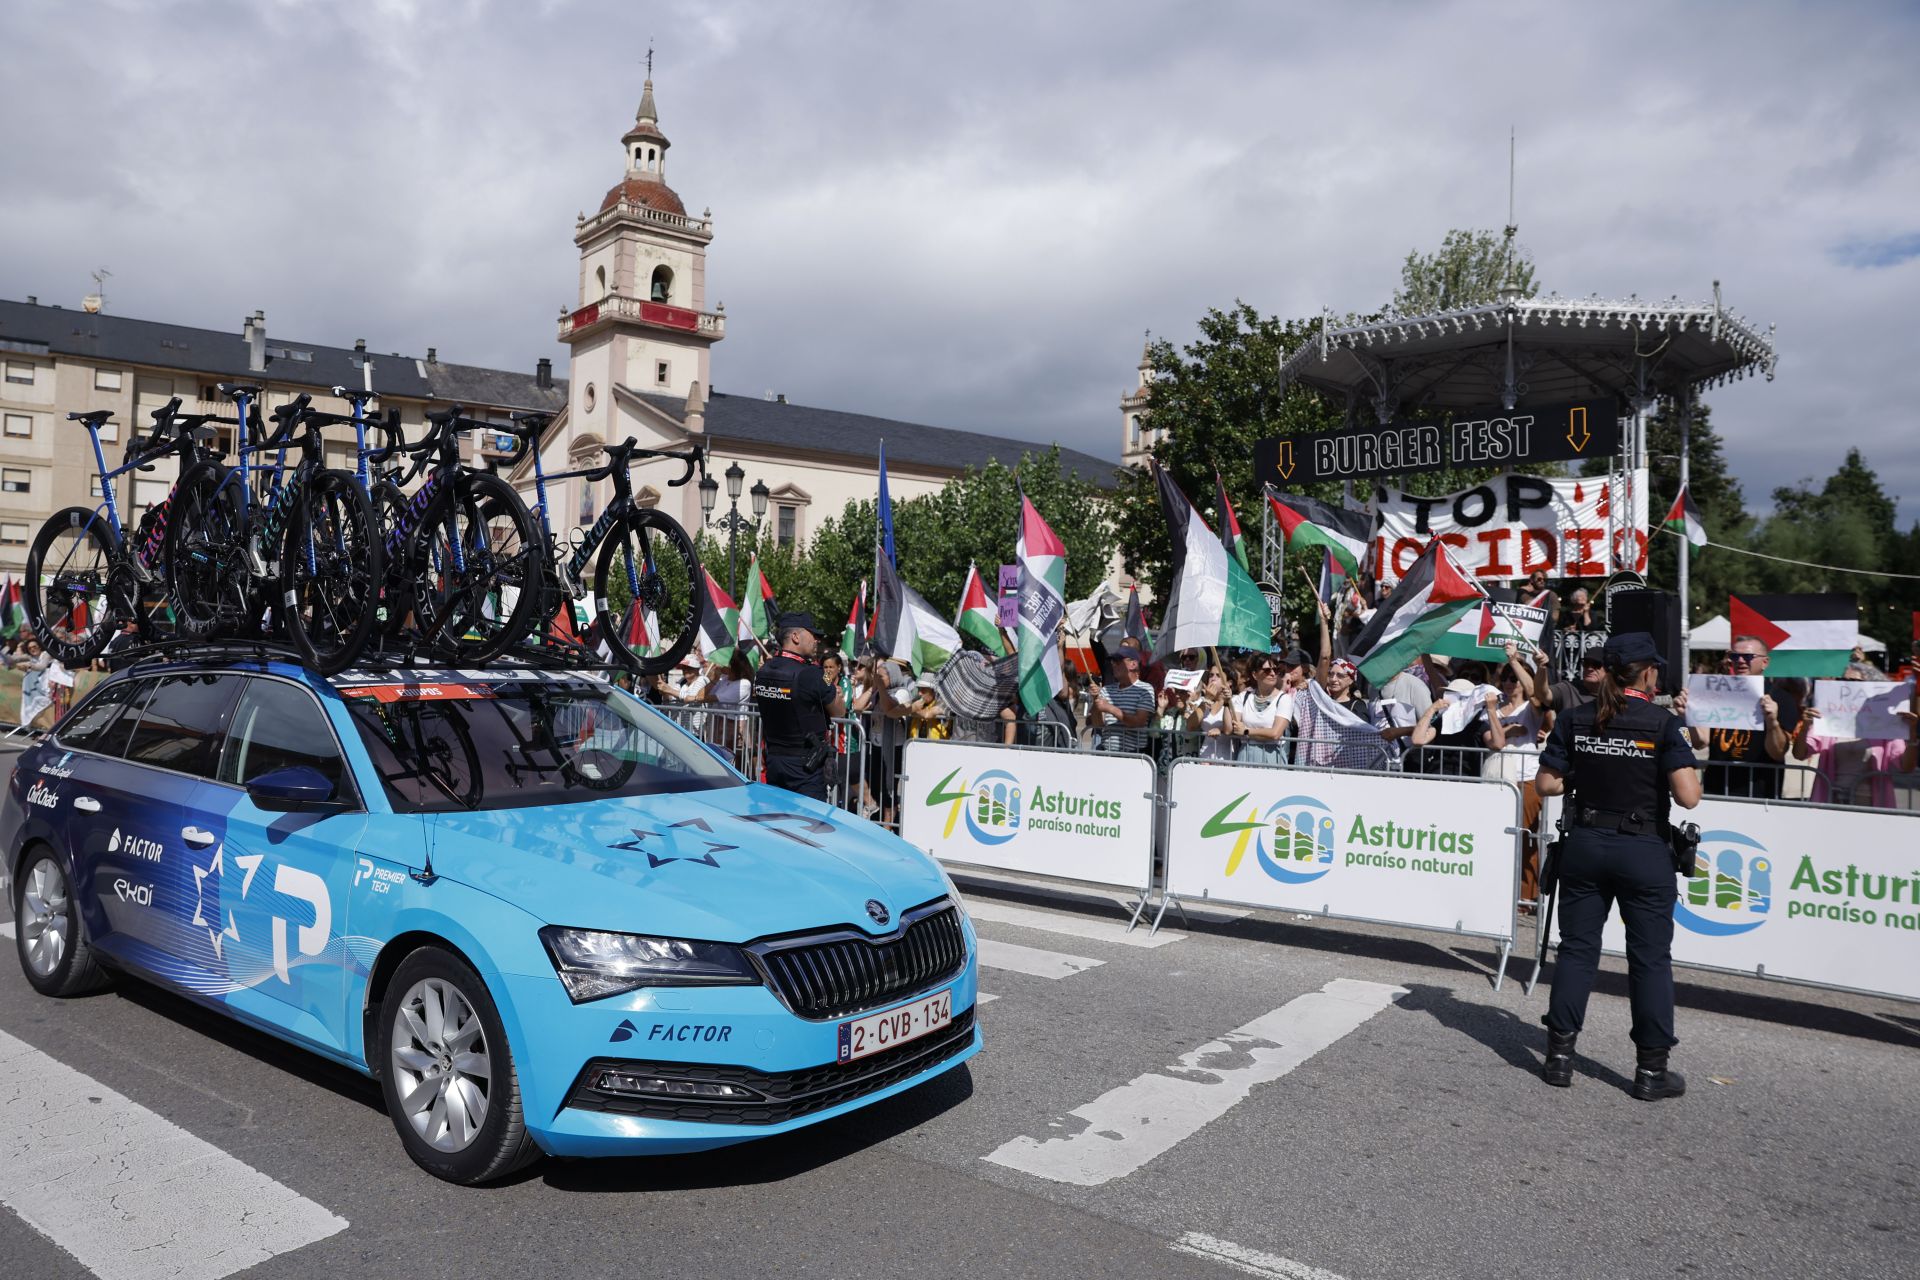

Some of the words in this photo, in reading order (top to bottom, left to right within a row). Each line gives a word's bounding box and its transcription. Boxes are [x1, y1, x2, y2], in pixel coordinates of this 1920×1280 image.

[1314, 425, 1441, 476] BURGER
[1452, 415, 1535, 463] FEST
[669, 528, 696, 592] BLACK
[681, 603, 695, 633] INC
[1705, 676, 1749, 692] PAZ
[1574, 735, 1638, 749] POLICIA
[1575, 744, 1655, 759] NACIONAL
[1029, 785, 1122, 820] Asturias
[1028, 816, 1072, 832] paraíso
[1075, 822, 1121, 838] natural
[1346, 813, 1475, 855] Asturias
[124, 834, 163, 863] FACTOR
[373, 867, 406, 885] PREMIER
[1345, 850, 1407, 869] paraíso
[1411, 857, 1473, 877] natural
[371, 880, 391, 894] TECH
[1788, 900, 1877, 925] paraíso
[648, 1023, 732, 1043] FACTOR
[853, 1000, 949, 1053] 2-CVB-134
[840, 1044, 849, 1058] B
